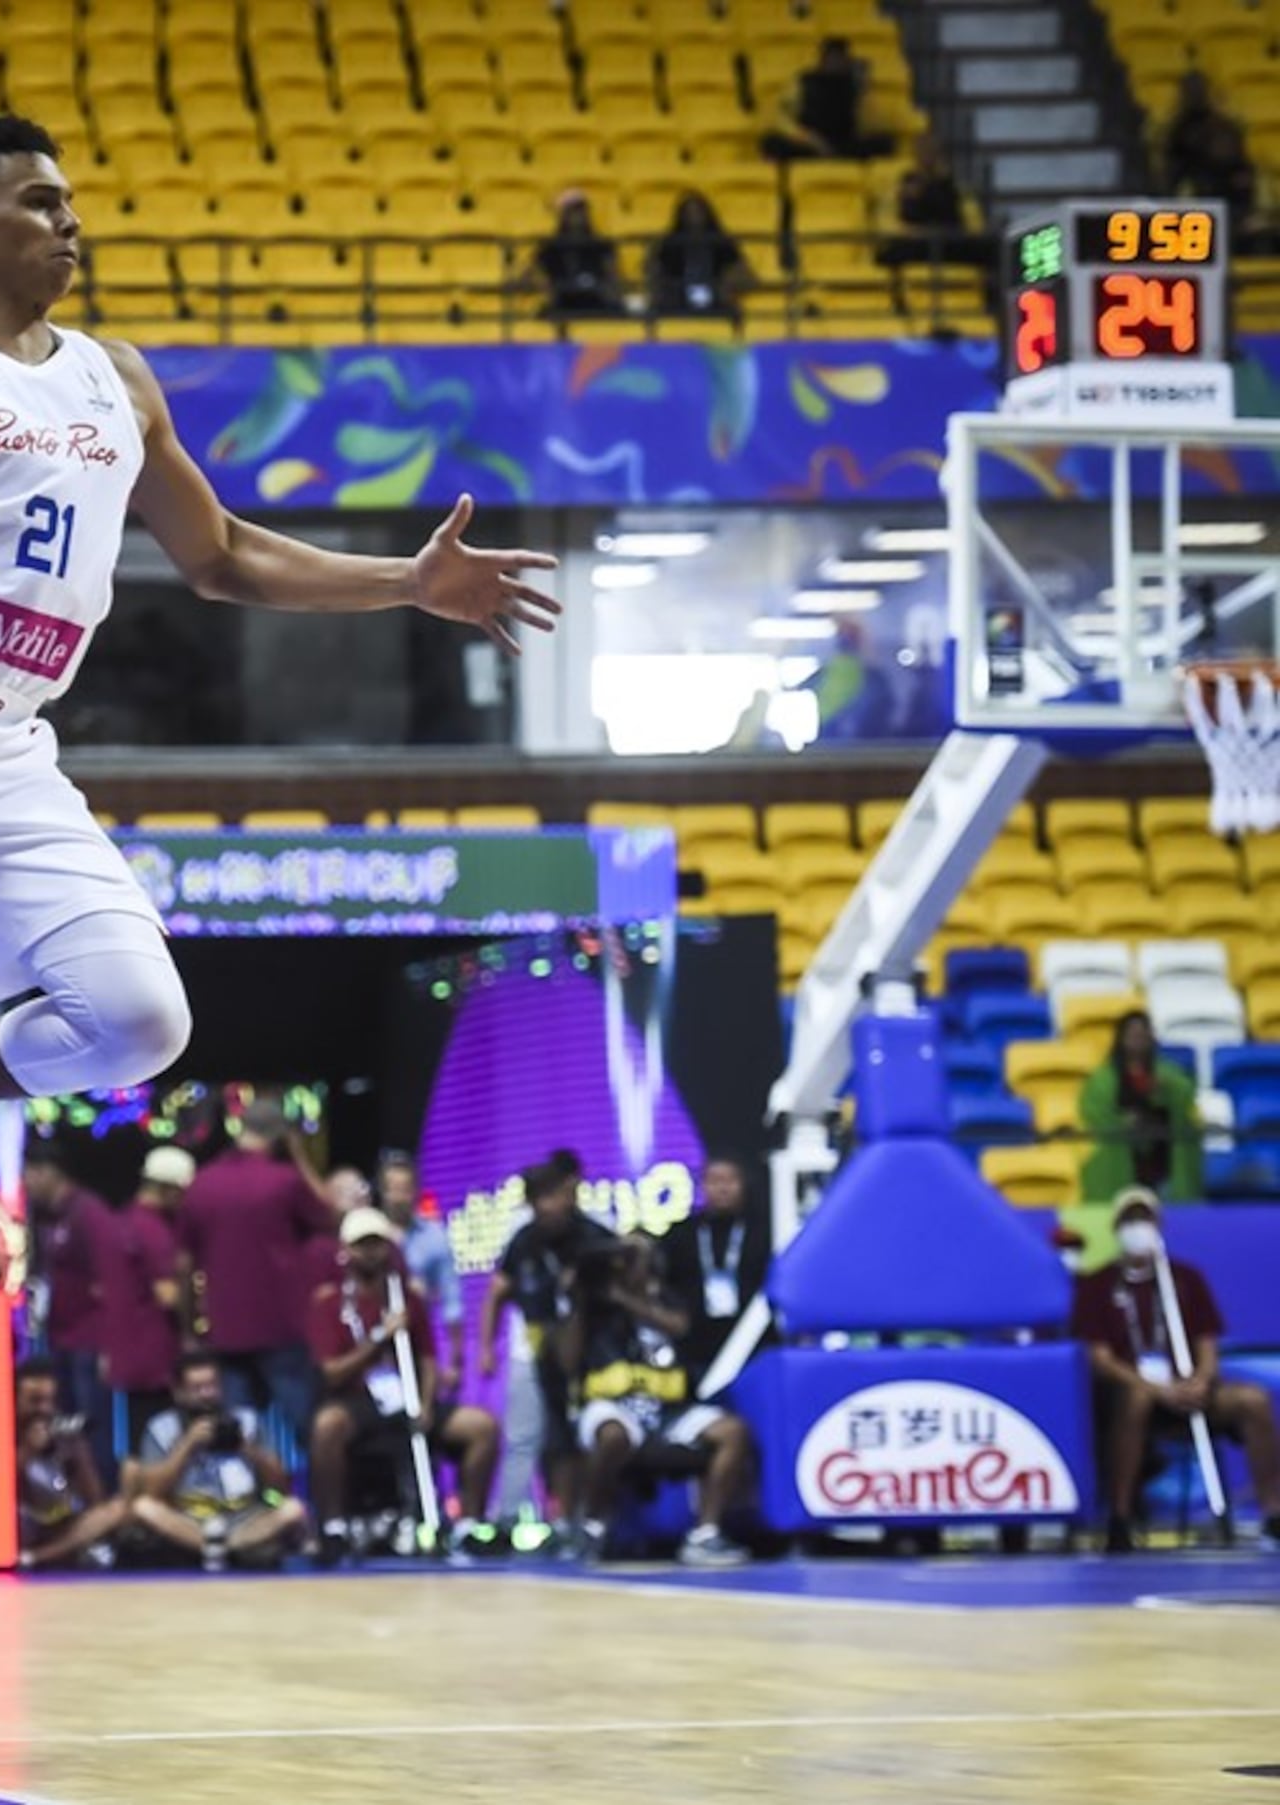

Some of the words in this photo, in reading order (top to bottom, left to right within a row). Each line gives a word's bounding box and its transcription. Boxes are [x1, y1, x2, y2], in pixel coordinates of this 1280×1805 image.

[1098, 274, 1195, 358] 24
[65, 423, 119, 471] Rico
[16, 494, 74, 579] 21
